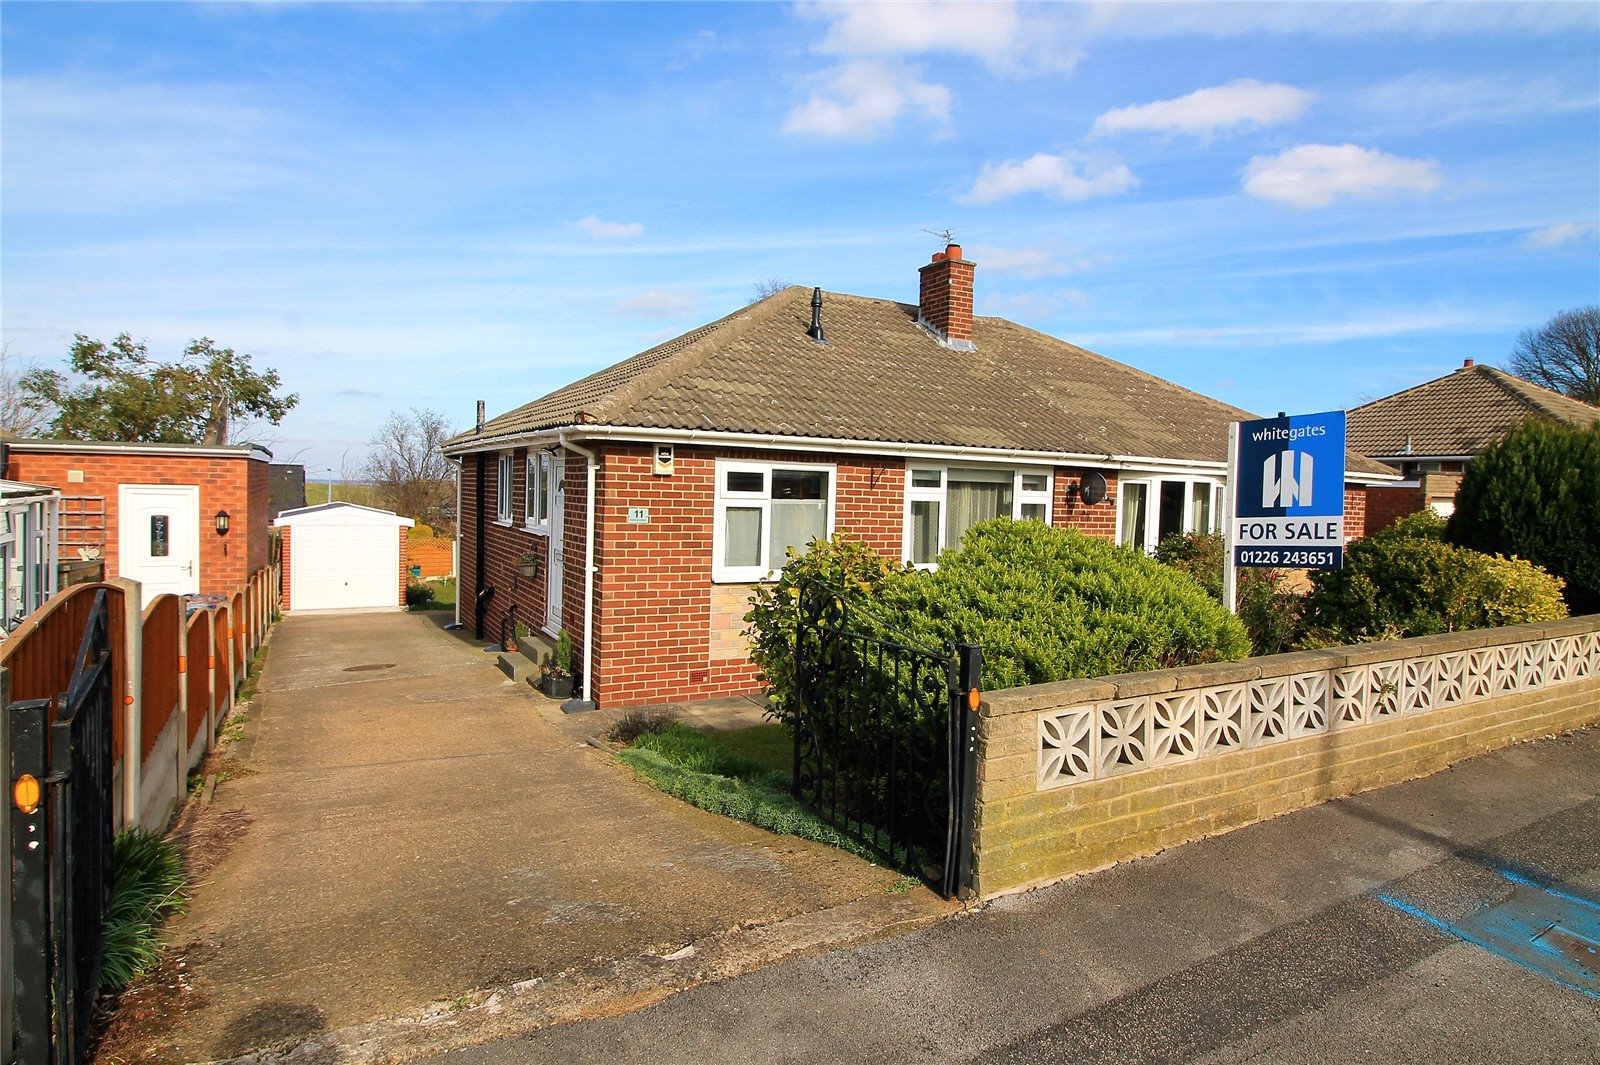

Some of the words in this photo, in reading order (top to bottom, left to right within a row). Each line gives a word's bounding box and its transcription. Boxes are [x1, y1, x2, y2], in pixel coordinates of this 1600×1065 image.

[1252, 425, 1326, 441] whitegates
[634, 510, 644, 518] 11
[1239, 523, 1277, 540] FOR
[1285, 522, 1338, 540] SALE
[1240, 551, 1279, 564] 01226
[1282, 551, 1334, 565] 243651
